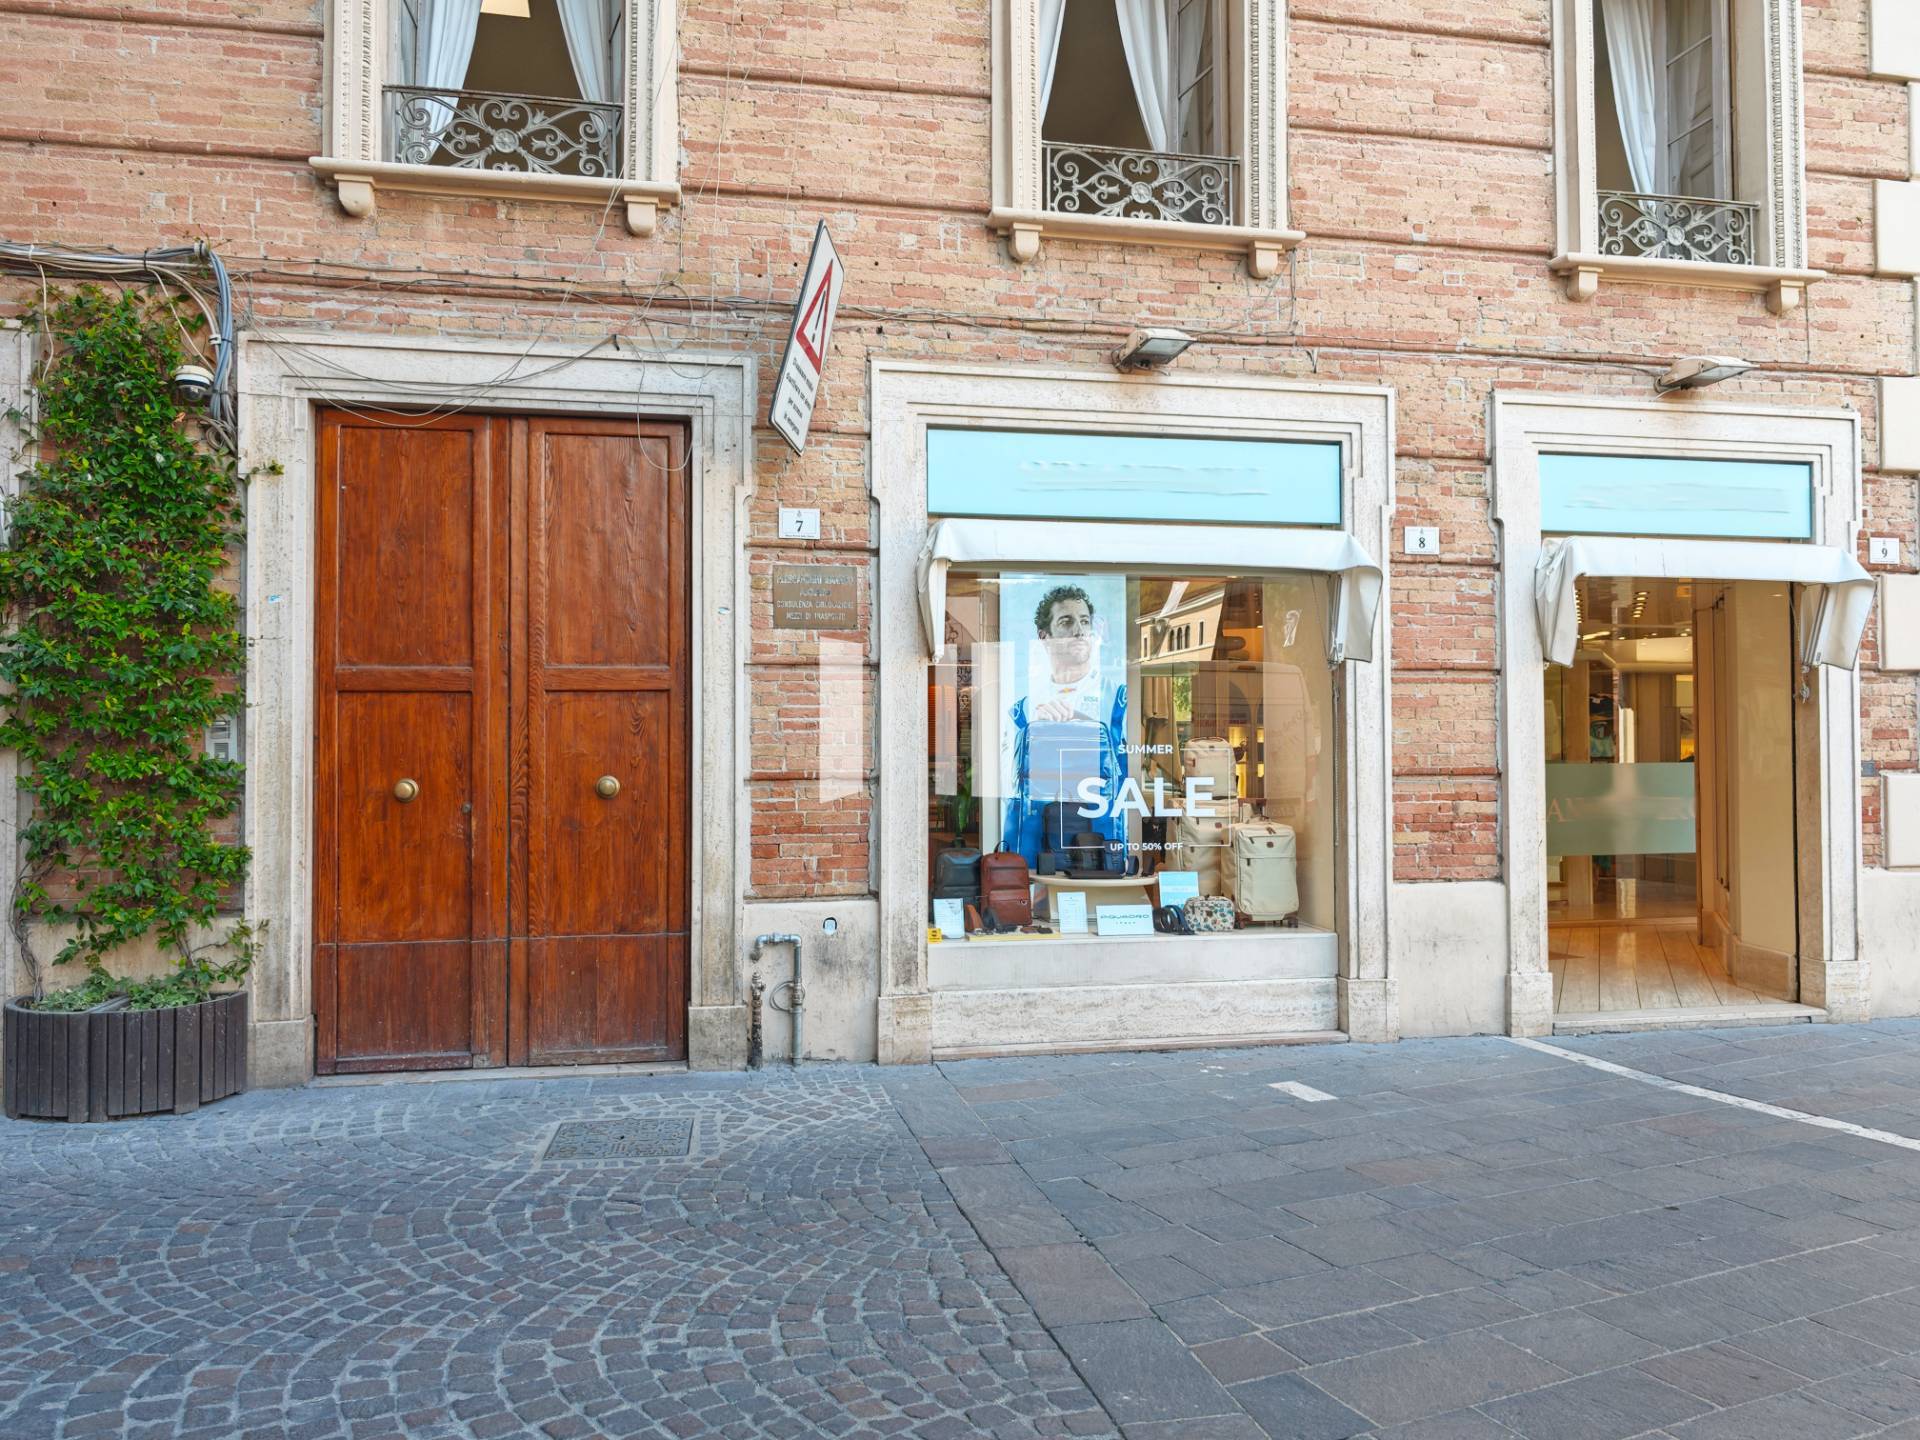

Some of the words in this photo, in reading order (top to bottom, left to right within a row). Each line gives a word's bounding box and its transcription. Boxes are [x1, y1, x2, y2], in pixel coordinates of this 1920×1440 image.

[795, 520, 804, 532] 7
[1418, 537, 1426, 549] 8
[1881, 547, 1888, 558] 9
[1118, 744, 1173, 755] SUMMER
[1076, 776, 1216, 819] SALE
[1109, 843, 1125, 852] UP
[1127, 843, 1140, 851] TO
[1142, 842, 1162, 851] 50%
[1164, 842, 1184, 850] OFF
